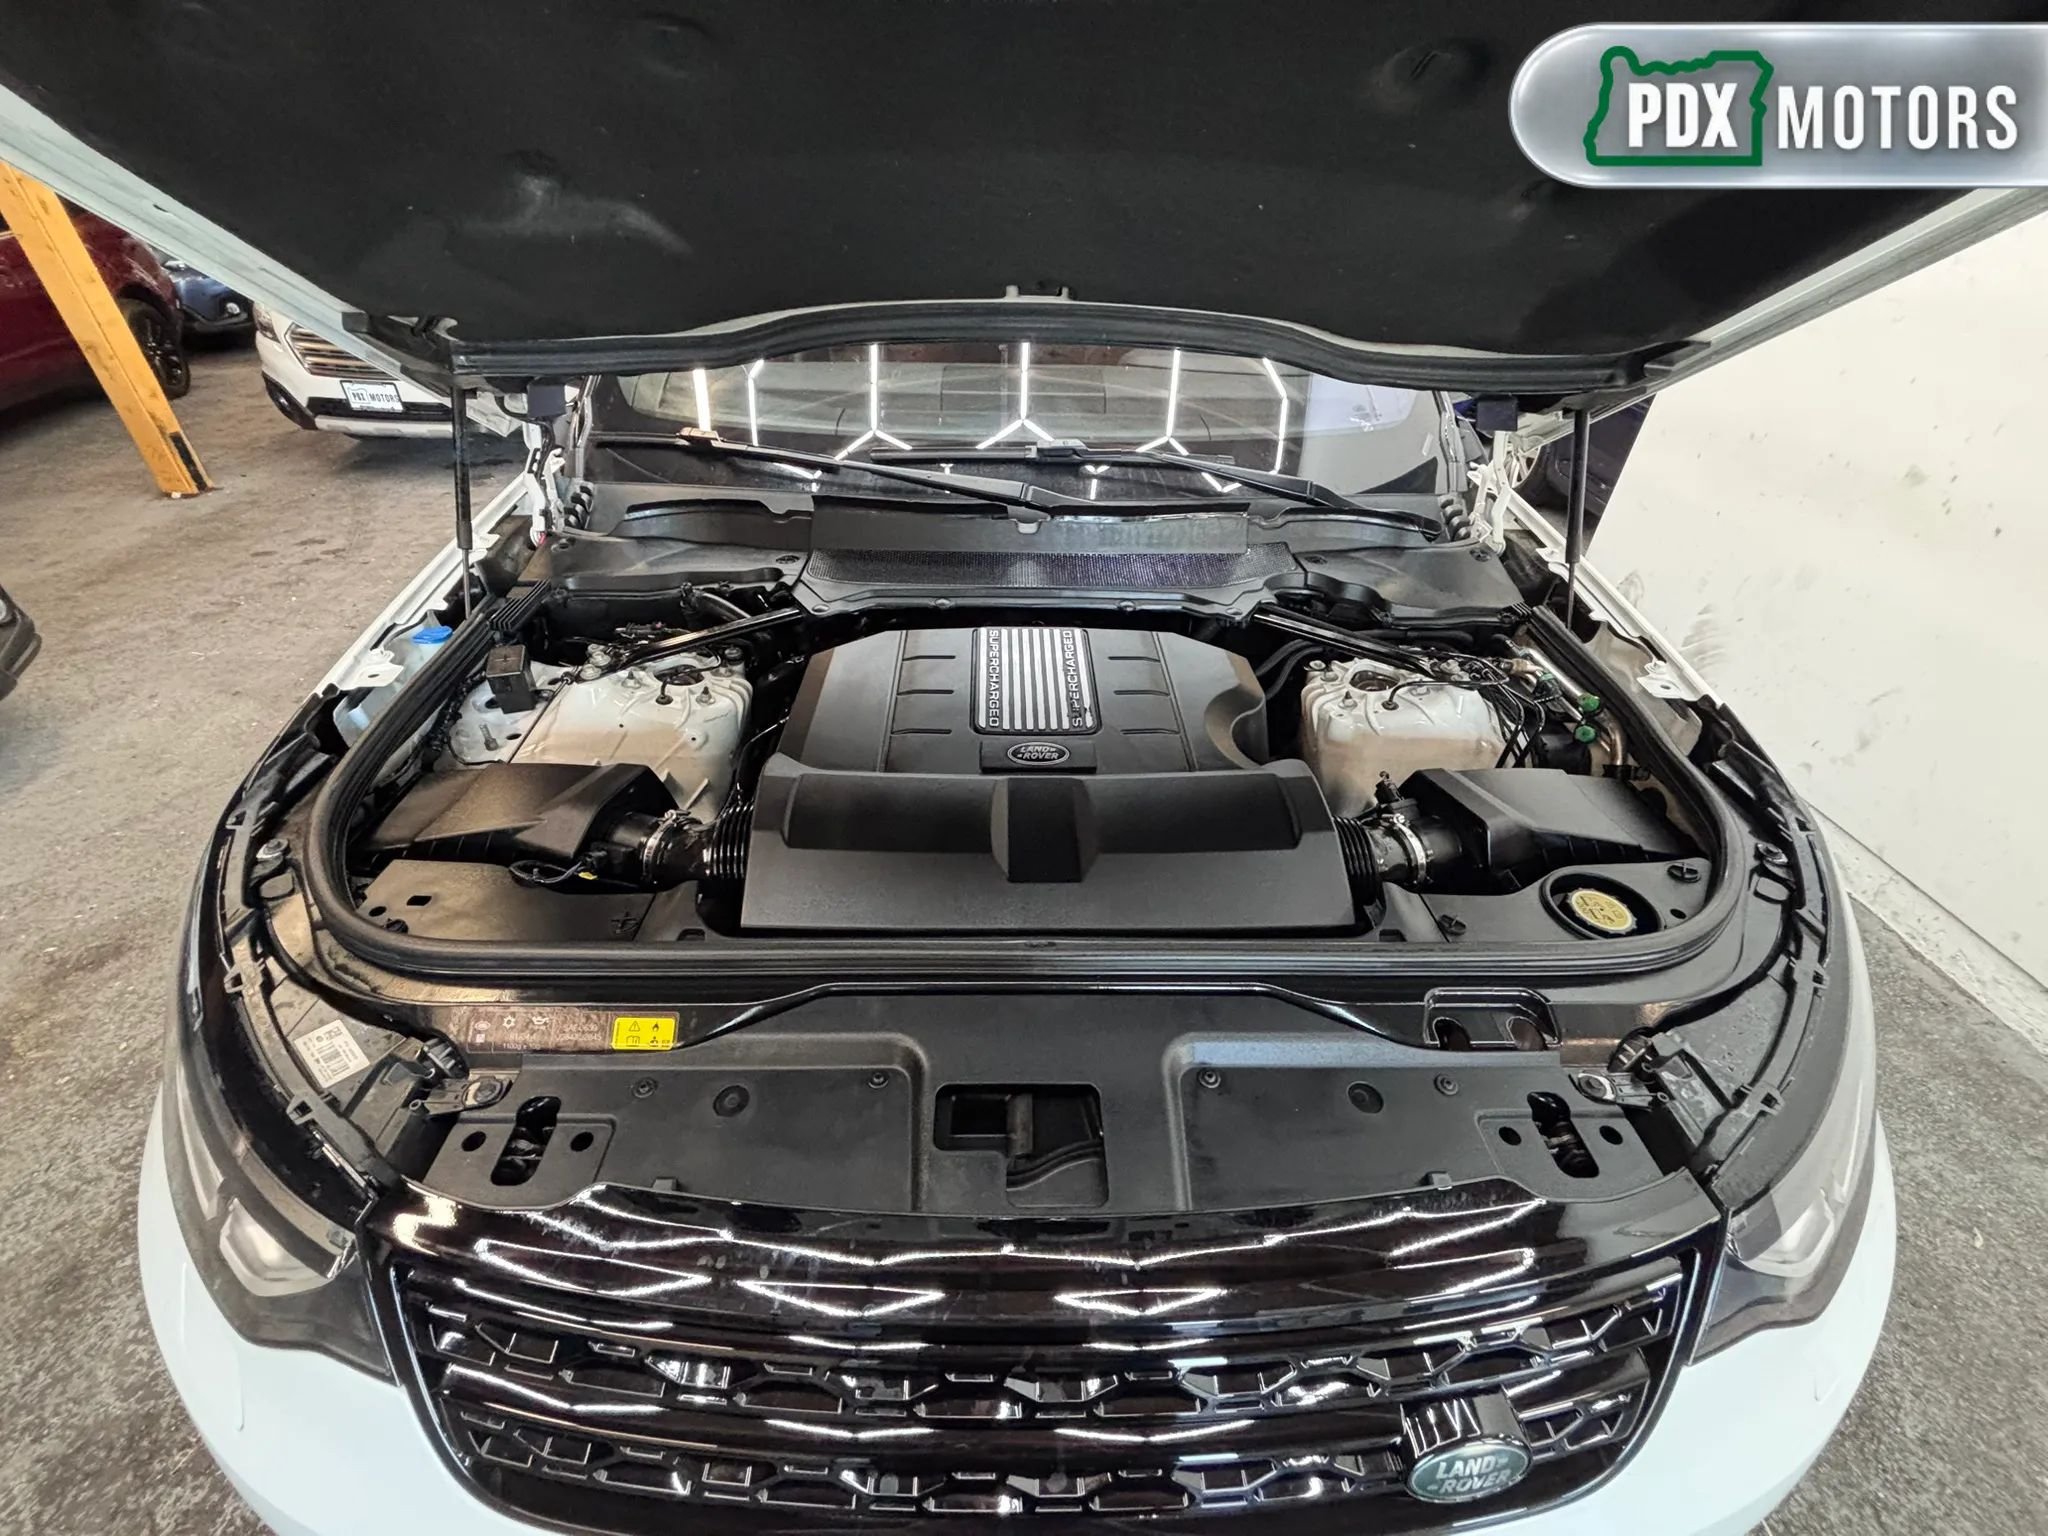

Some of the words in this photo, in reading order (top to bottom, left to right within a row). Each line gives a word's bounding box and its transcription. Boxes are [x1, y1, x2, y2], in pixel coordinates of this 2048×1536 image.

[368, 393, 400, 403] MOTORS
[989, 629, 1000, 727] SUPERCHARGED
[1022, 752, 1059, 760] ROVER
[1436, 1455, 1496, 1480] LAND
[1439, 1469, 1511, 1493] ROVER
